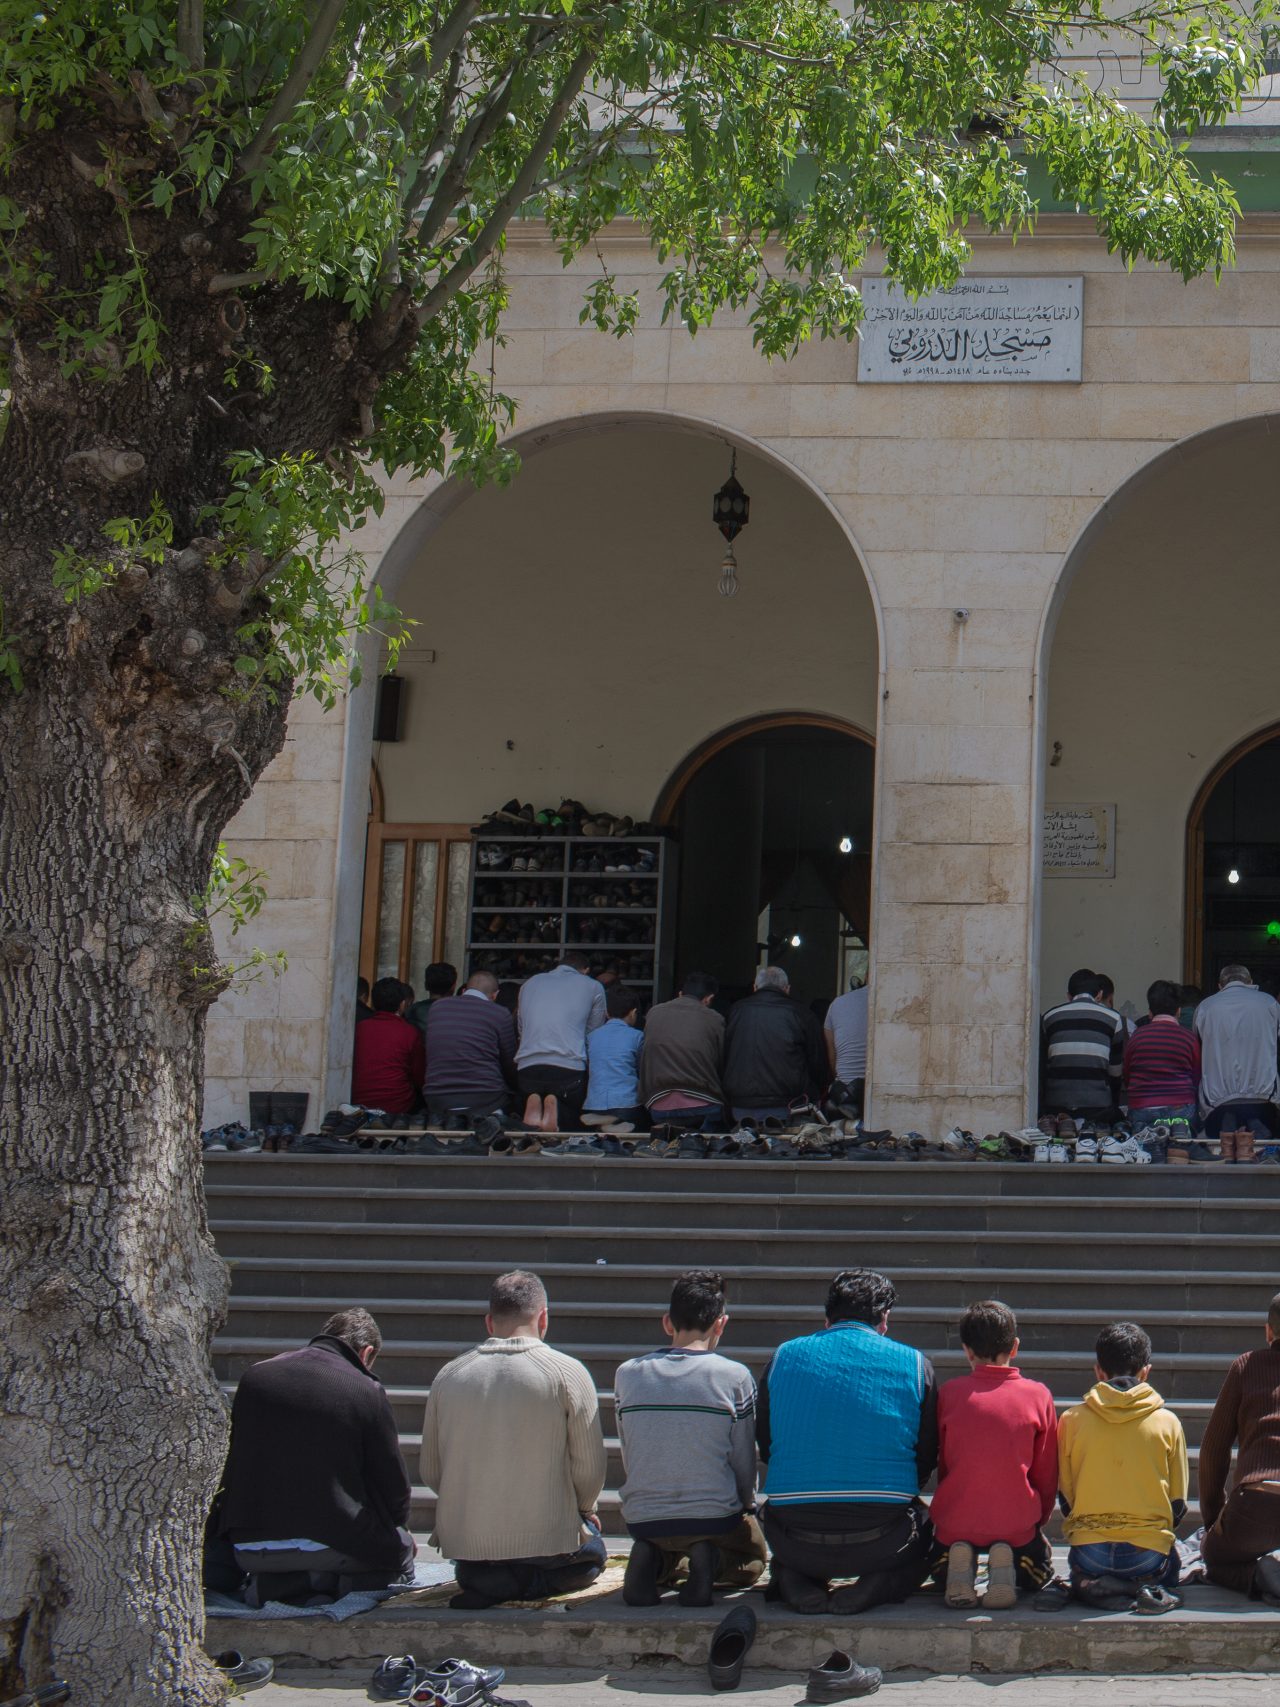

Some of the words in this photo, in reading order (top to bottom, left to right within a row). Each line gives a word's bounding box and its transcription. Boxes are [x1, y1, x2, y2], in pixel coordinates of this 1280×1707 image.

[972, 284, 986, 294] الله
[987, 284, 1010, 296] بسم
[924, 306, 946, 322] بالله
[965, 306, 980, 321] من
[980, 306, 998, 321] الله
[998, 305, 1031, 323] مساجد
[887, 327, 971, 364] الدروبي
[970, 327, 1053, 362] مسجد
[975, 365, 990, 375] عام
